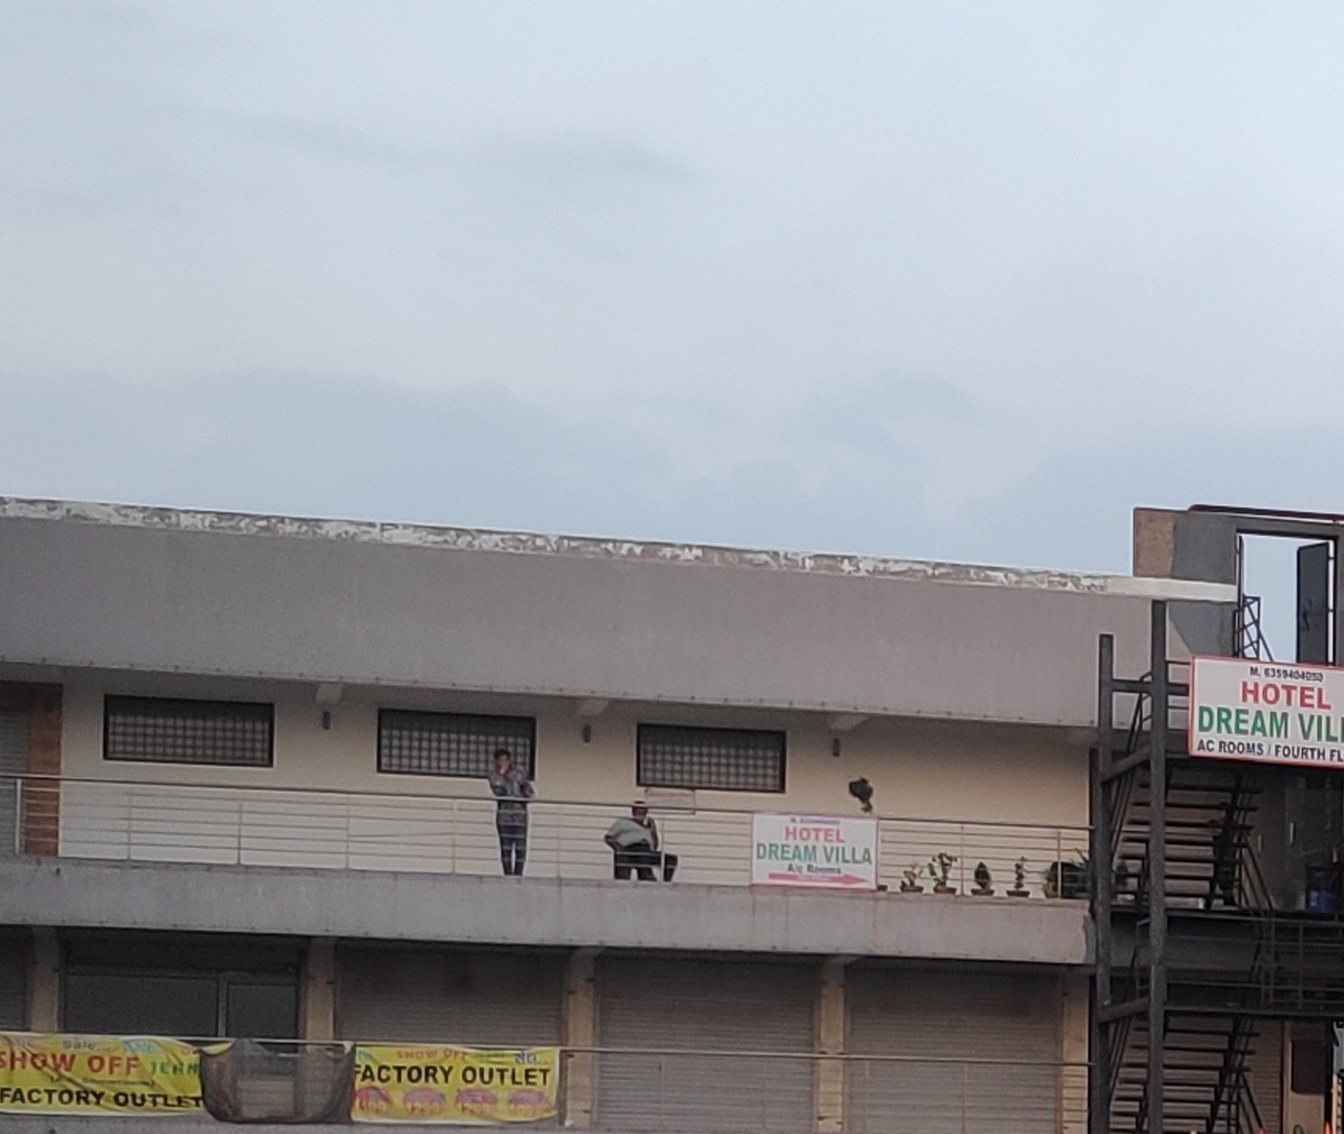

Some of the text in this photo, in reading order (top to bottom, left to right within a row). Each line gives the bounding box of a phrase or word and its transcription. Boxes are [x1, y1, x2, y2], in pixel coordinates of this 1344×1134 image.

[1241, 681, 1332, 710] HOTEL
[1198, 705, 1289, 739] DREAM
[1197, 739, 1215, 752] AC
[1218, 741, 1264, 756] ROOMS
[1274, 744, 1325, 761] FOURTH
[785, 826, 846, 843] HOTEL
[756, 843, 873, 865] DREAM VILLA
[0, 1051, 76, 1072] SHOW
[87, 1055, 141, 1076] OFF
[354, 1065, 551, 1085] FACTORY OUTLET
[0, 1087, 205, 1108] FACTORY OUTLET
